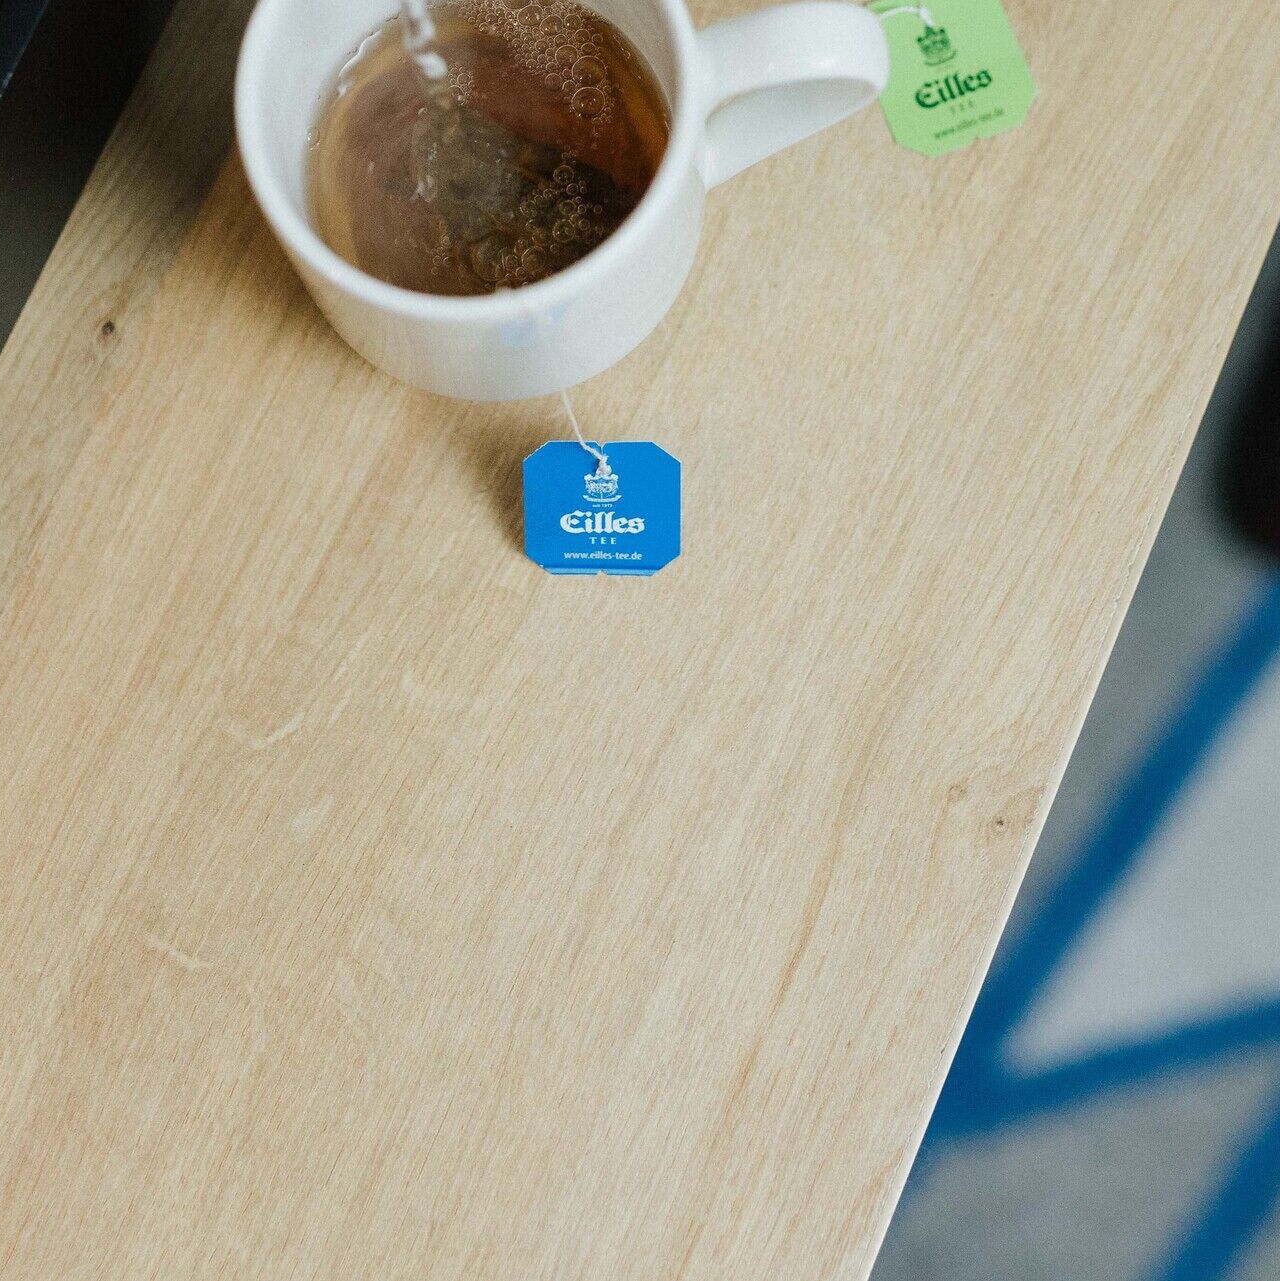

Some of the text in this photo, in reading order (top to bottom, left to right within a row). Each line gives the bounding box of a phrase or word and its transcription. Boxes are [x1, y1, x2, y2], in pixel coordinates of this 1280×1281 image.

[915, 69, 993, 108] Eilles
[559, 510, 646, 534] Eilles
[589, 536, 617, 545] TEE
[563, 551, 643, 560] www.eilles-tee.de
